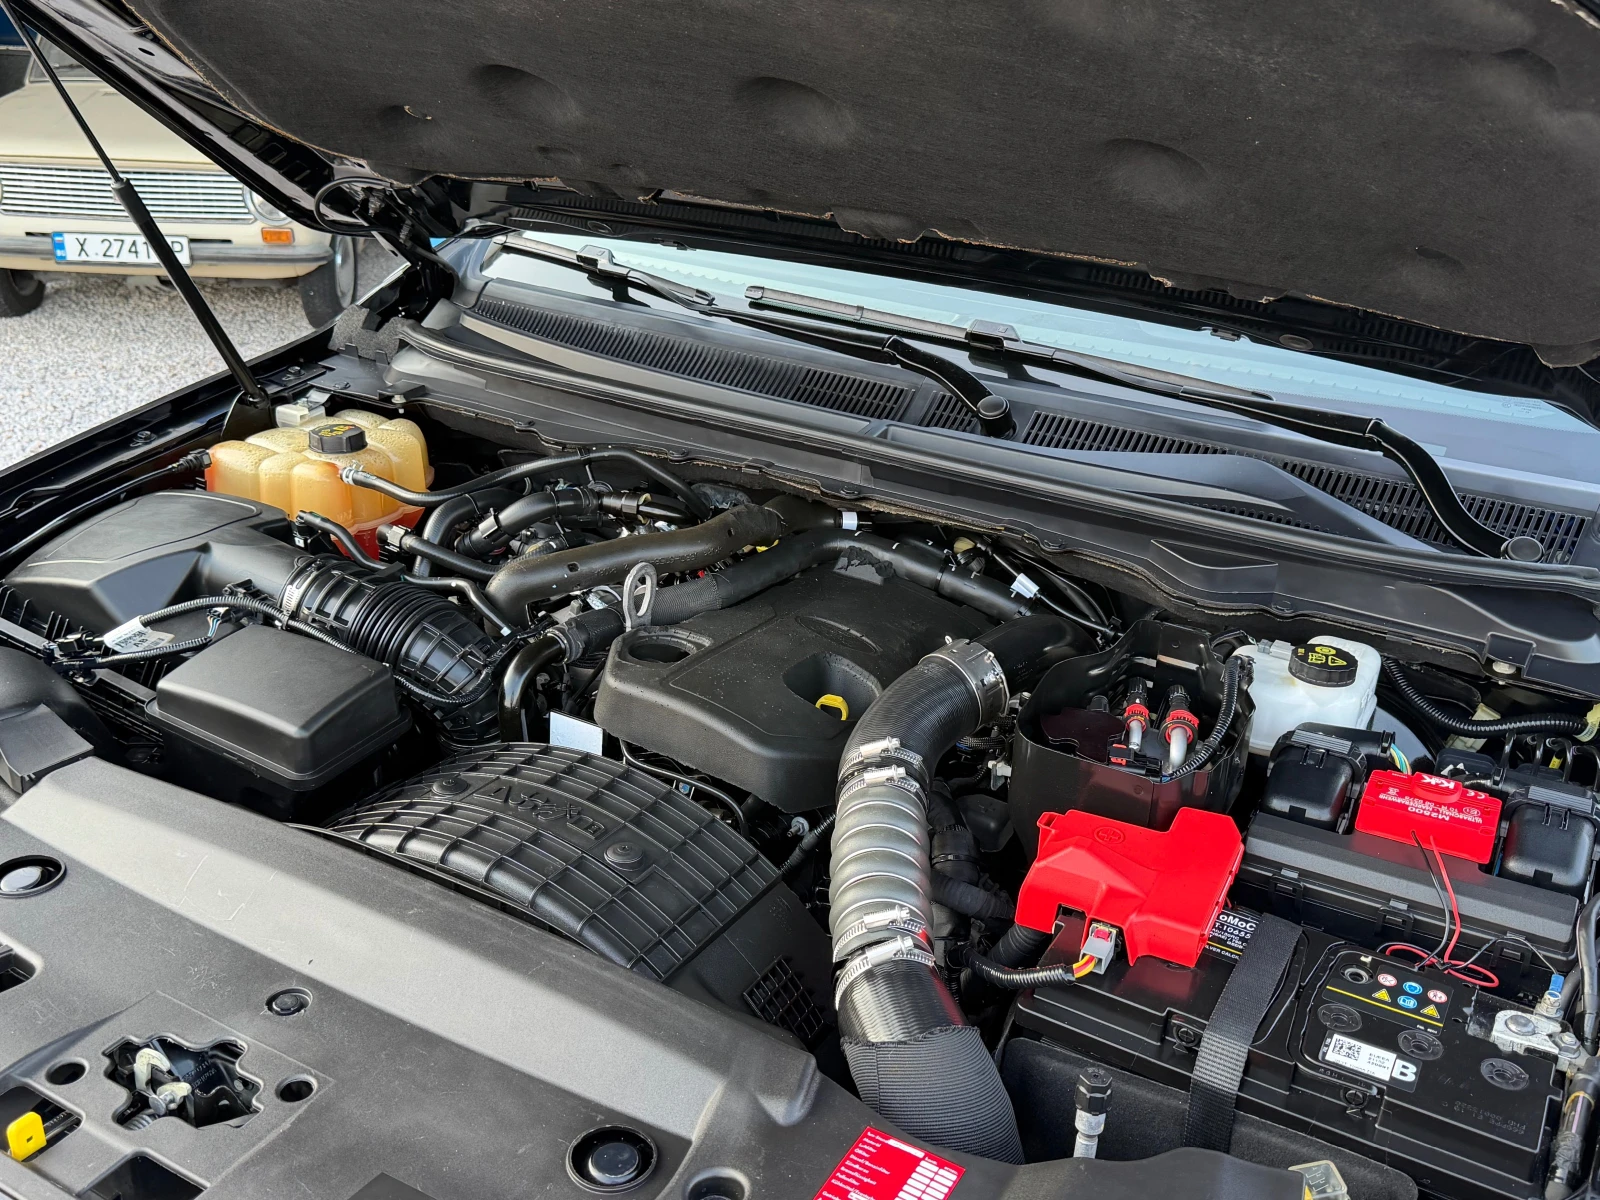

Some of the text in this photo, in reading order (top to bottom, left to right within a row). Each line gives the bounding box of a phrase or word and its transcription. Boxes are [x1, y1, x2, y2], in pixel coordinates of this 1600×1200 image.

[1215, 922, 1251, 939] T-10655
[1219, 914, 1256, 930] oMoC
[1391, 1058, 1417, 1081] B
